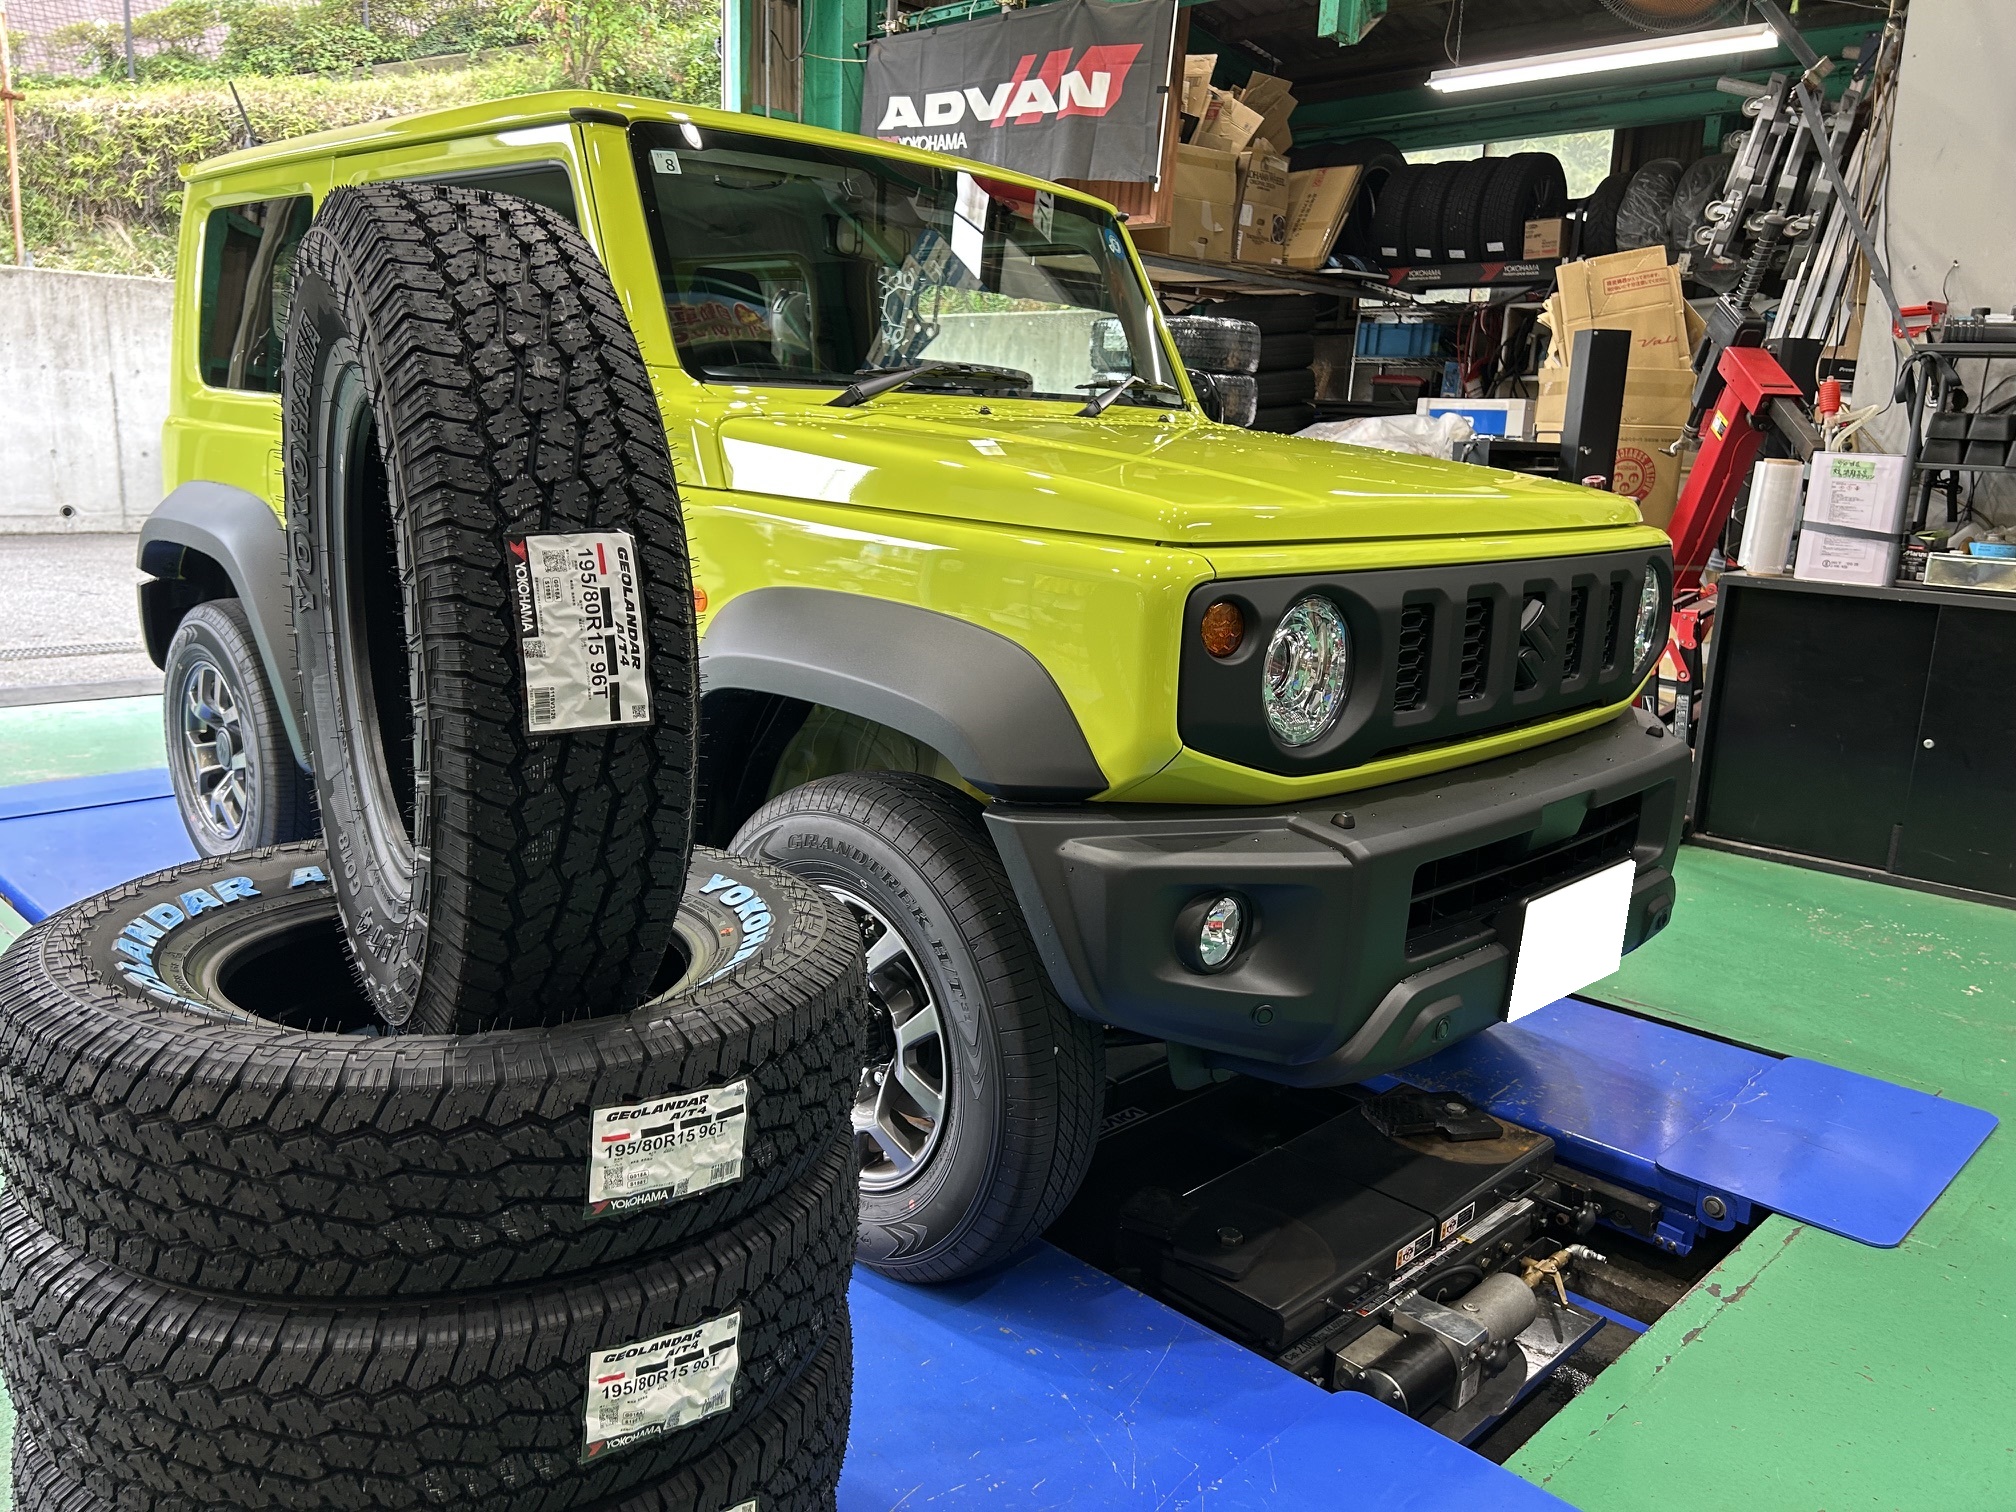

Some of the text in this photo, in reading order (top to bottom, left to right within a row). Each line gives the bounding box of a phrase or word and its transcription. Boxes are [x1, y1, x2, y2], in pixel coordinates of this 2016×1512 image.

[877, 70, 1112, 130] ADVAN
[898, 132, 968, 151] YOKOHAMA
[665, 158, 676, 172] 8
[291, 307, 321, 613] YOKOHAMA
[514, 561, 534, 632] YOKOHAMA
[617, 546, 641, 670] GEOLANDAR
[578, 548, 608, 699] 195/80R15 96T
[615, 621, 630, 667] A/T4
[787, 832, 934, 928] GRANDTREK
[606, 1094, 709, 1123] GEOLANDAR
[669, 1106, 707, 1122] A/T4
[604, 1120, 728, 1160] 195/80R15 96T
[610, 1189, 669, 1210] YOKOHAMA
[602, 1329, 703, 1364] GEOLANDAR
[665, 1342, 699, 1359] A/T4
[602, 1353, 720, 1400] 195/80R15 96T
[606, 1425, 662, 1450] YOKOHAMA
